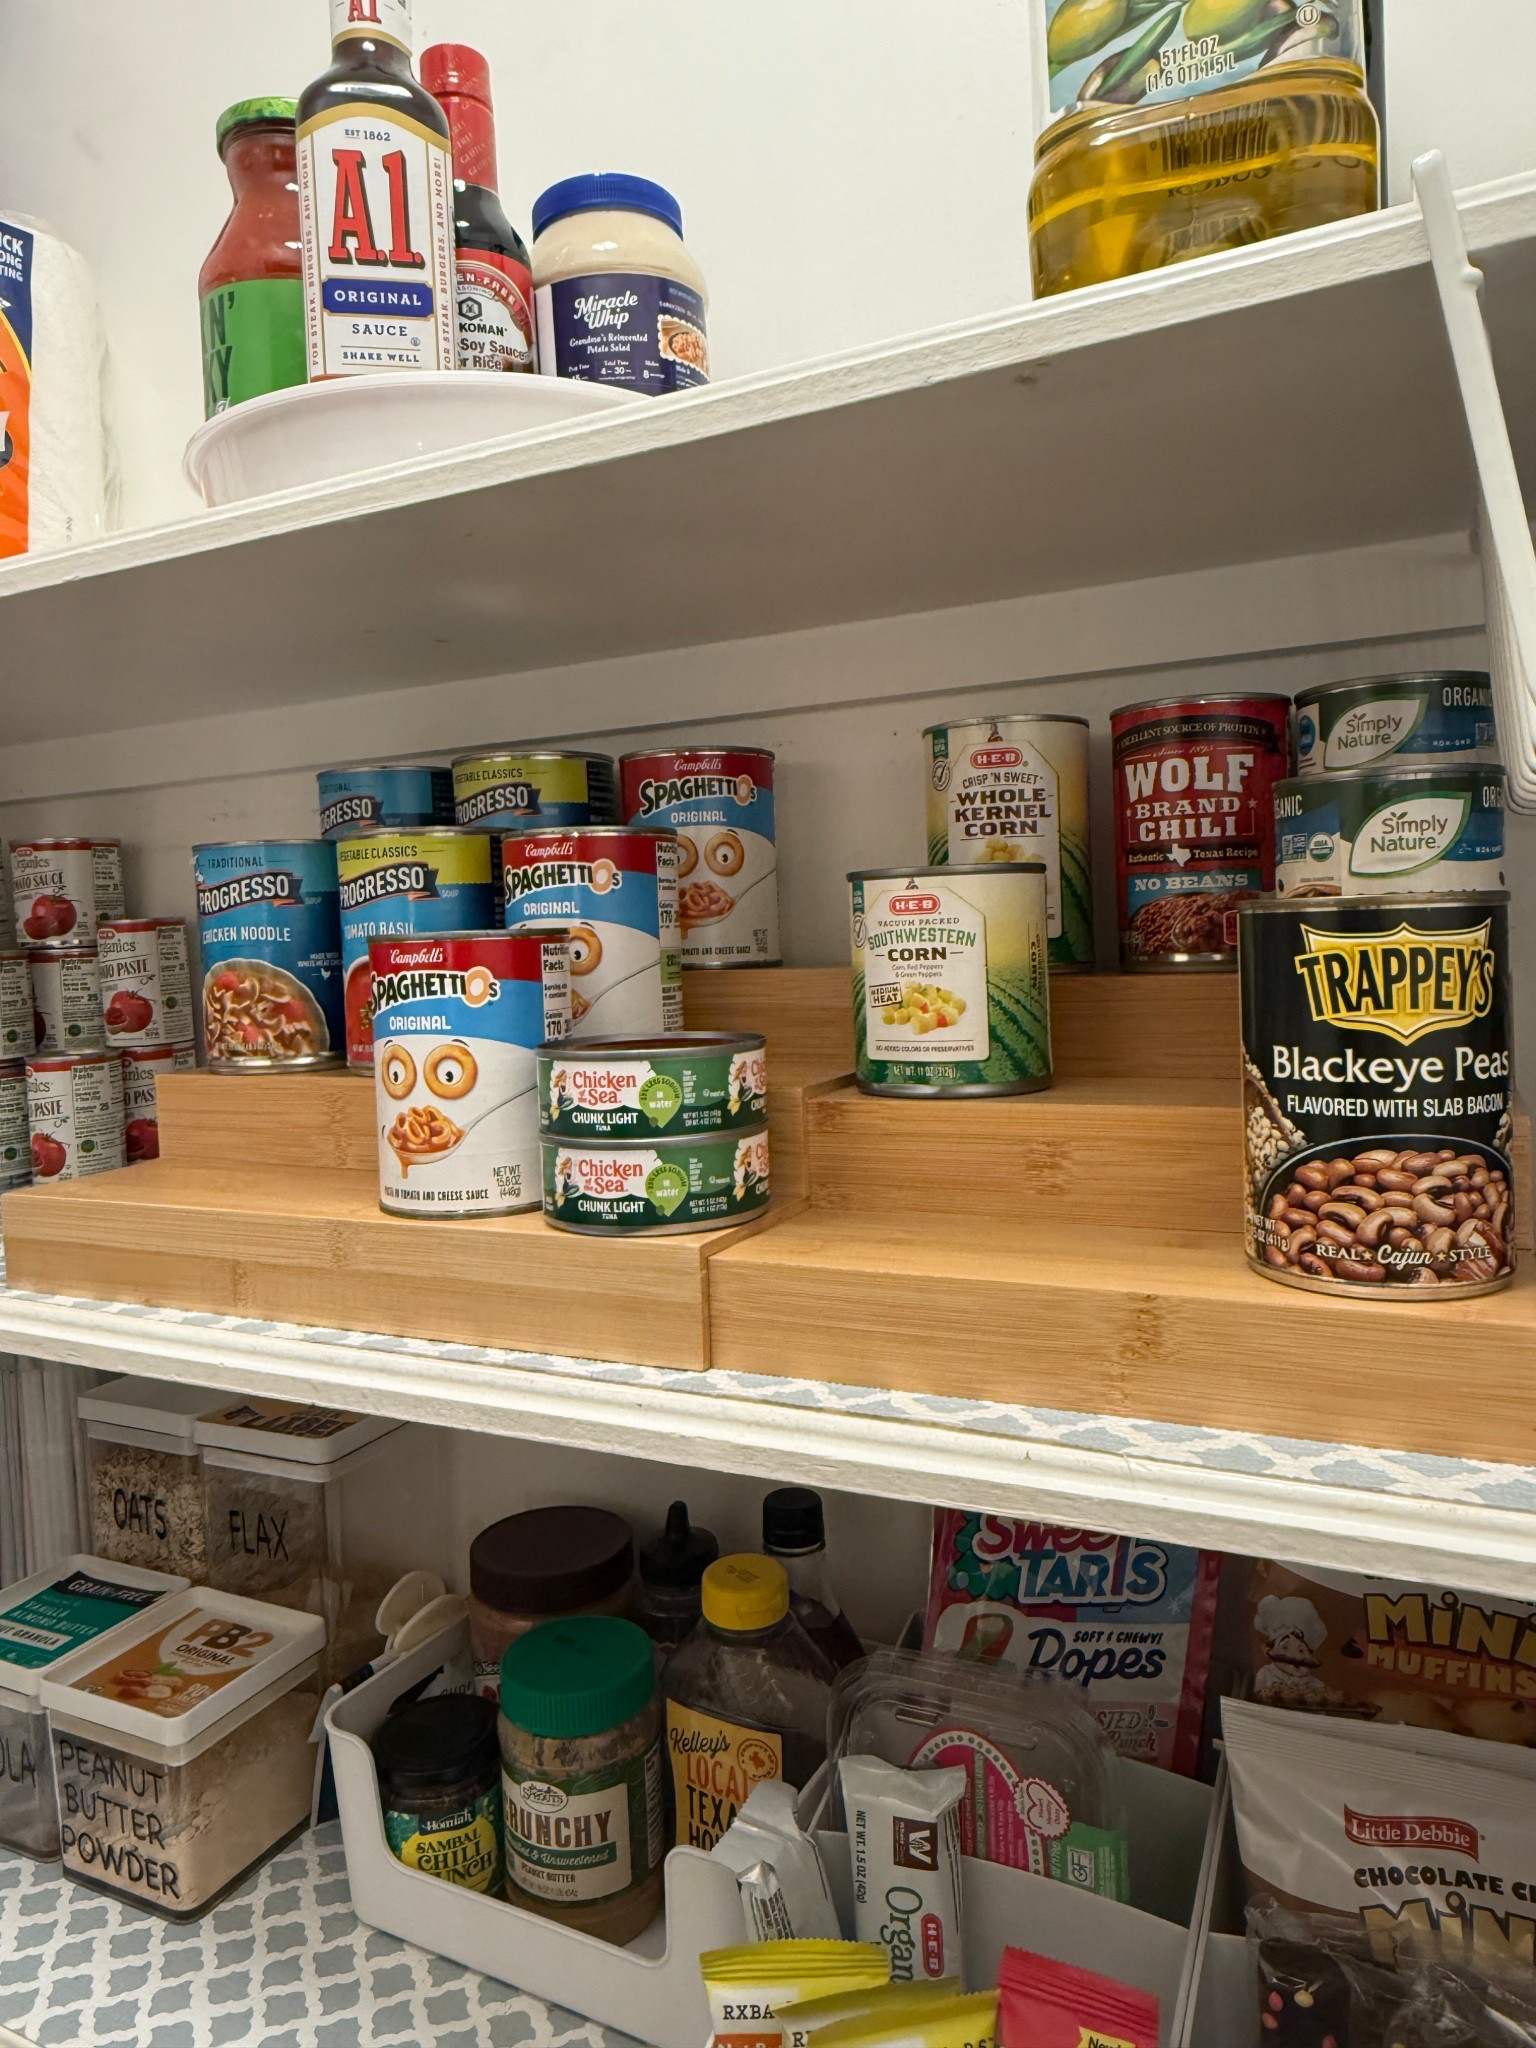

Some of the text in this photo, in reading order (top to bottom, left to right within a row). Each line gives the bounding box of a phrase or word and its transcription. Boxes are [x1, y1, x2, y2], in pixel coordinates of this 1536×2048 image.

[1199, 36, 1218, 57] OZ
[344, 128, 392, 142] EST 1862
[303, 194, 312, 220] AND
[435, 205, 445, 229] AND
[333, 289, 422, 306] ORIGINAL
[573, 290, 638, 320] Miracle
[584, 307, 630, 329] Whip
[351, 323, 408, 336] SAUCE
[342, 351, 420, 363] SHAKE WELL
[460, 338, 526, 361] Soy Sauce
[587, 342, 631, 354] Potato Salad
[311, 351, 320, 366] FOR
[443, 349, 453, 371] FOR
[472, 354, 503, 370] Rice
[1162, 722, 1260, 736] SOURCE OF PROTEIN
[1346, 712, 1403, 735] Simply
[1337, 733, 1393, 751] Nature
[482, 767, 523, 781] CLASSICS
[673, 758, 722, 772] Campbell's
[962, 773, 989, 790] CRISP
[1004, 771, 1039, 785] SWEET
[1124, 753, 1255, 804] WOLF
[956, 787, 1046, 807] WHOLE
[954, 804, 1052, 823] KERNEL
[1134, 796, 1241, 819] BRAND
[671, 810, 727, 824] ORIGINAL
[1382, 813, 1448, 836] Simply
[964, 820, 1038, 837] CORN
[1139, 815, 1237, 843] CHILI
[371, 844, 418, 859] CLASSICS
[524, 842, 574, 858] Campbell's
[1193, 846, 1259, 859] Texas Recipe
[1370, 835, 1437, 853] Nature
[207, 856, 264, 869] TRADITIONAL
[340, 867, 425, 911] PROGRESSO
[1134, 873, 1249, 892] NO BEANS
[199, 874, 289, 914] PROGRESSO
[523, 901, 580, 915] ORIGINAL
[878, 917, 960, 928] VACUUM PACKED
[241, 925, 291, 942] NOODLE
[868, 927, 977, 951] SOUTHWESTERN
[390, 947, 444, 966] Campbell's
[887, 946, 947, 962] CORN
[1296, 943, 1495, 1021] TRAPPEY'S
[873, 993, 899, 1005] HEAT
[389, 1015, 451, 1031] ORIGINAL
[546, 1019, 562, 1037] 170
[1272, 1045, 1510, 1093] Blackeye Peas
[572, 1070, 638, 1091] Chicken
[587, 1089, 620, 1106] Sea
[649, 1099, 673, 1109] water
[1287, 1094, 1504, 1119] FLAVORED WITH SLAB BACON
[571, 1111, 639, 1125] CHUNK LIGHT
[493, 1166, 508, 1178] NET
[578, 1159, 644, 1180] Chicken
[422, 1189, 436, 1201] AND
[437, 1190, 464, 1202] CHEESE
[465, 1188, 490, 1200] SAUCE
[595, 1177, 626, 1195] Sea
[656, 1187, 680, 1198] water
[577, 1200, 646, 1213] CHUNK LIGHT
[601, 1212, 619, 1220] TUNA
[1315, 1243, 1492, 1271] REAL Cajun STYLE
[113, 1487, 168, 1541] OATS
[228, 1509, 290, 1562] FLAX
[67, 1579, 150, 1602] GRAIN-FREE
[25, 1600, 71, 1618] VANILLA
[10, 1609, 100, 1635] ALMOND BUTTER
[11, 1630, 60, 1647] GRANOLA
[182, 1618, 275, 1658] PB2
[1073, 1630, 1164, 1646] SOFT CHEWY!
[174, 1643, 237, 1667] ORIGINAL
[1367, 1643, 1536, 1700] MUFFINS
[669, 1727, 731, 1760] Kelley's
[58, 1738, 169, 1804] PEANUT
[63, 1782, 167, 1850] BUTTER
[856, 1810, 867, 1829] NET
[415, 1827, 482, 1854] SAMBAL
[856, 1830, 867, 1848] WT.
[1350, 1818, 1471, 1848] Little Debbie
[61, 1824, 181, 1900] POWDER
[856, 1849, 867, 1865] 1.5
[546, 1872, 576, 1884] BUTTER
[856, 1865, 867, 1879] OZ
[1353, 1865, 1505, 1896] CHOCOLATE
